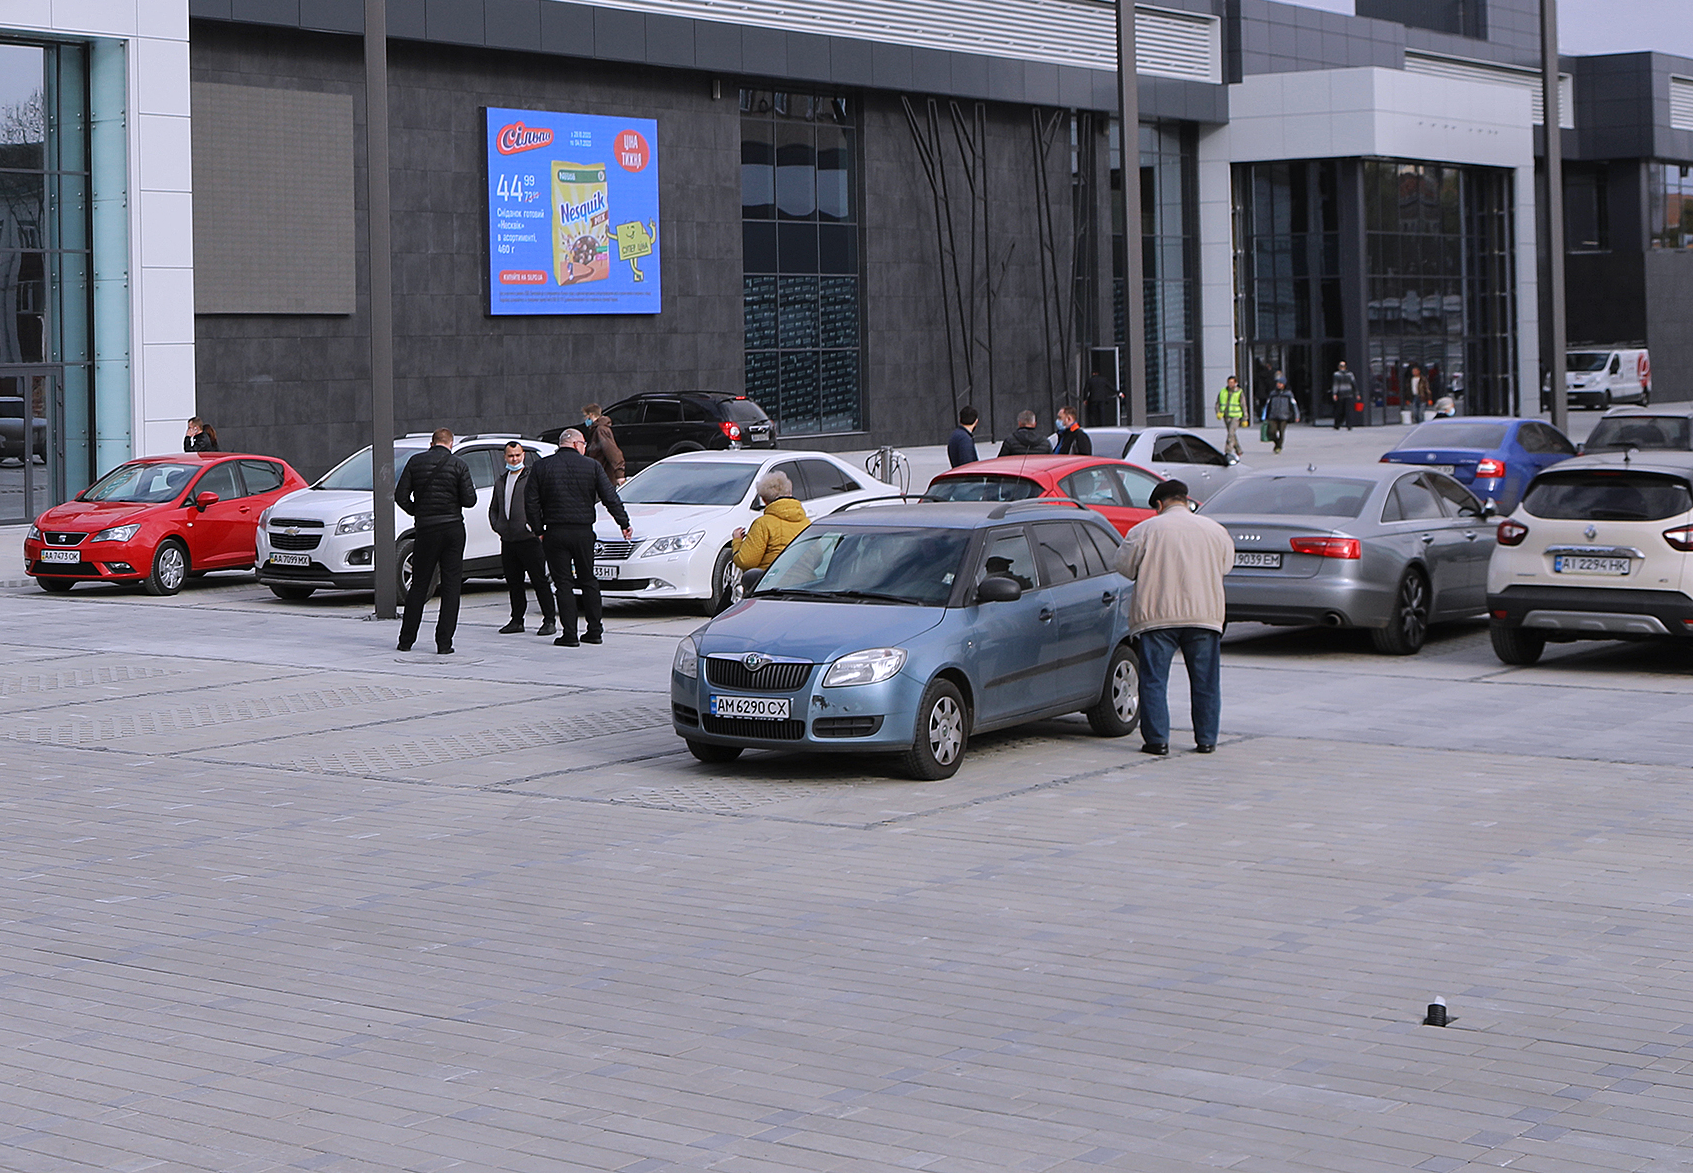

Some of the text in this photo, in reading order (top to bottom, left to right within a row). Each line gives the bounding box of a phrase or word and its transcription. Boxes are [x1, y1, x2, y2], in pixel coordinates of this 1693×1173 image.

[502, 126, 551, 150] Сільпо
[624, 135, 638, 150] ЦІНА
[497, 174, 522, 202] 44
[524, 176, 534, 186] 99
[561, 190, 605, 224] Nesquik
[1579, 559, 1606, 569] 2294
[718, 698, 786, 715] AM 6290 CX
